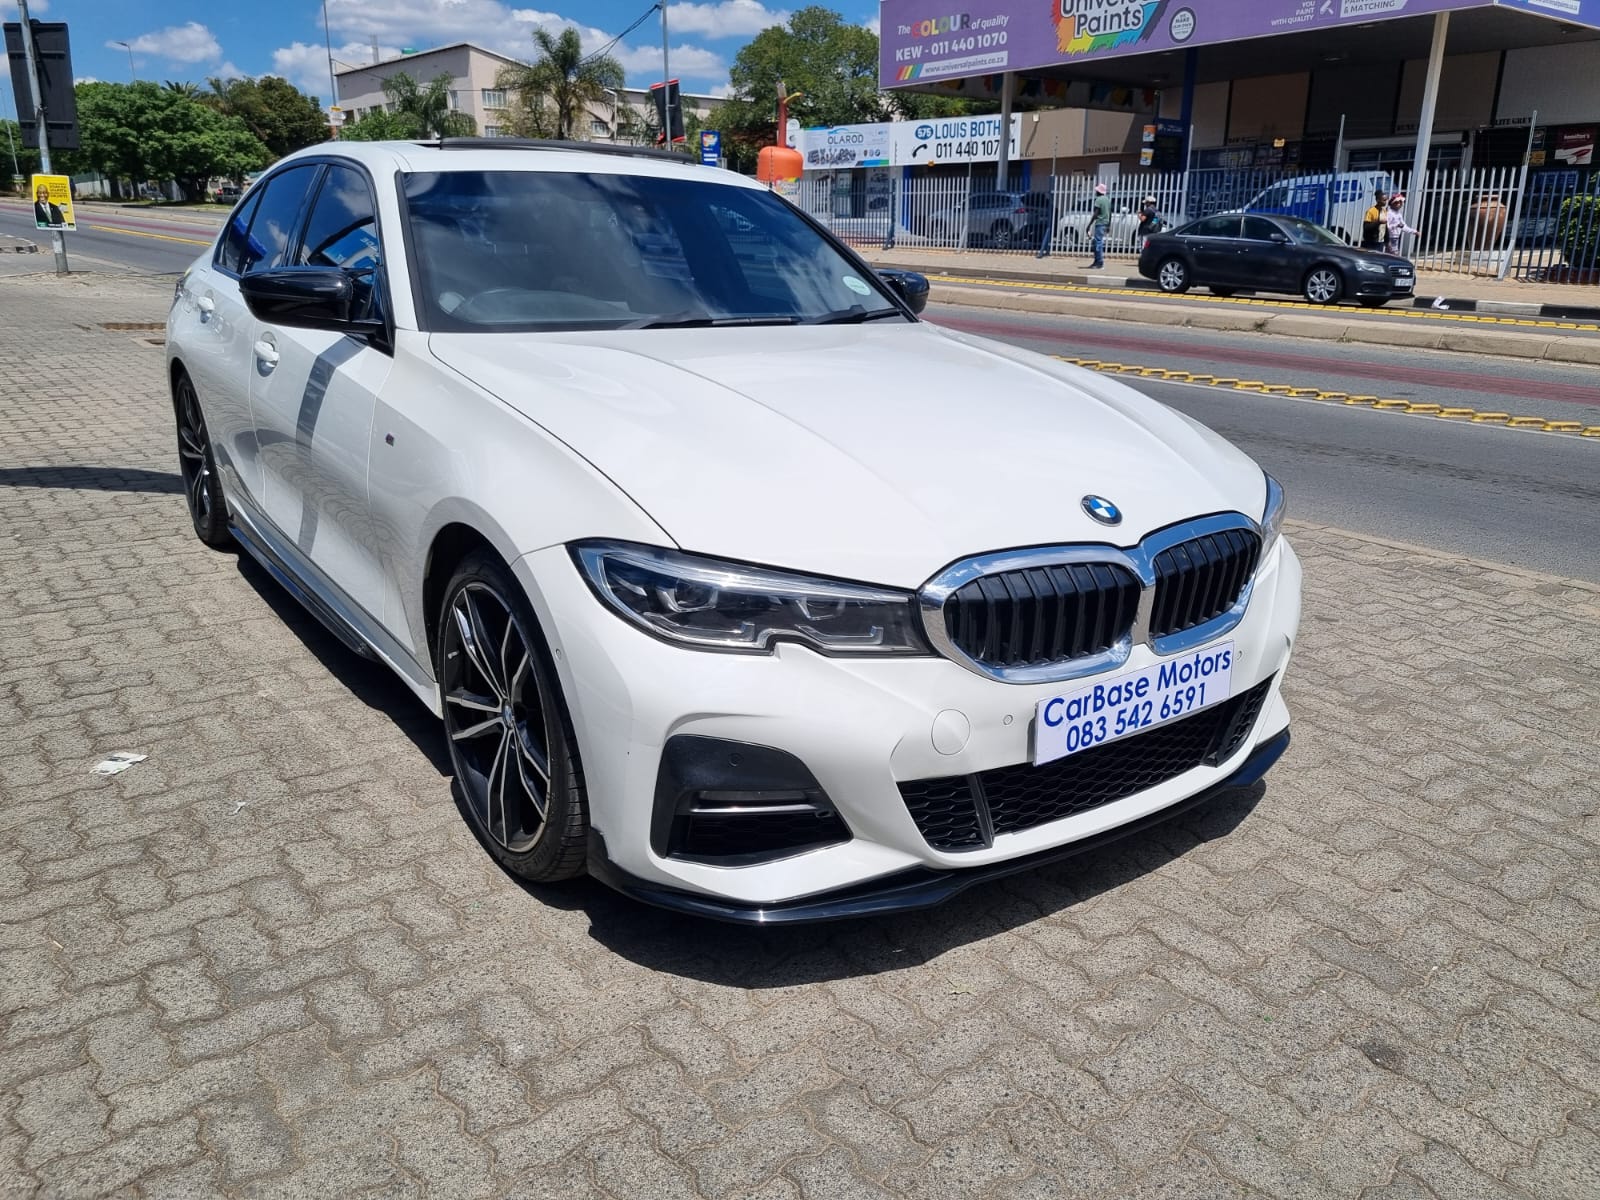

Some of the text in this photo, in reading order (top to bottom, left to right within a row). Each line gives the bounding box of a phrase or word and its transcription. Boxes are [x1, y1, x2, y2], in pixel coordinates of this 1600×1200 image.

[1350, 1, 1396, 13] MATCHING
[897, 13, 1010, 38] The COLOUR of quality
[1076, 7, 1142, 36] Paints
[1287, 14, 1315, 25] QUALITY
[895, 45, 923, 62] KEW
[931, 41, 949, 56] 011
[951, 37, 975, 53] 440
[977, 31, 1008, 47] 1070
[827, 134, 864, 145] OLAROD
[935, 122, 968, 140] LOUIS
[970, 119, 1003, 138] BOTH
[936, 142, 953, 159] 011
[955, 141, 979, 158] 440
[982, 138, 1016, 156] 1071
[1043, 649, 1231, 728] CarBase Motors
[1066, 682, 1206, 752] 083 542 6591
